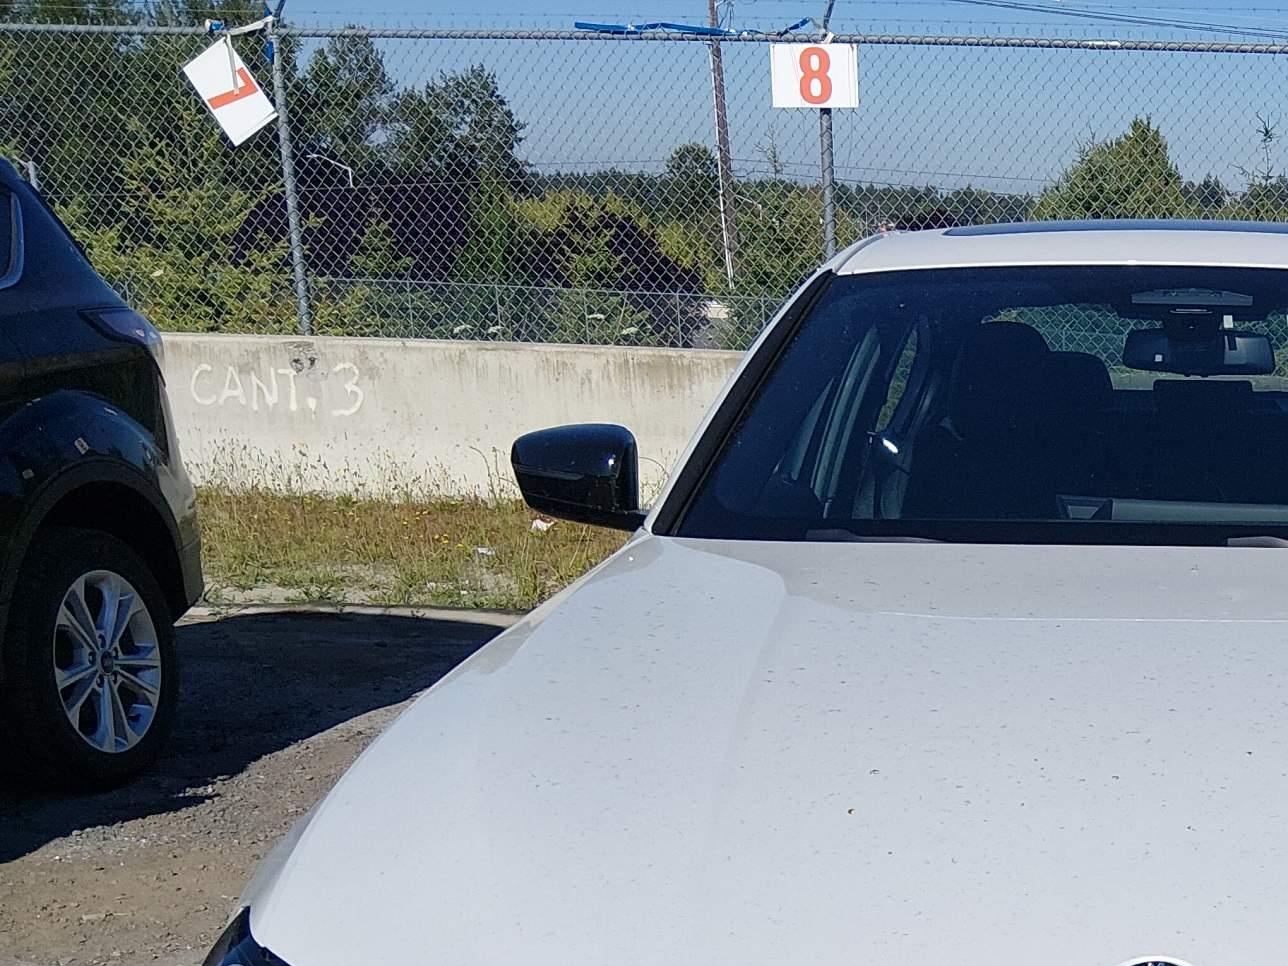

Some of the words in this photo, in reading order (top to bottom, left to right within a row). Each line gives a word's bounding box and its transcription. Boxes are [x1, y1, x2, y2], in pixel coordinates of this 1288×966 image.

[207, 66, 259, 110] 7
[799, 47, 833, 104] 8
[332, 362, 364, 416] 3
